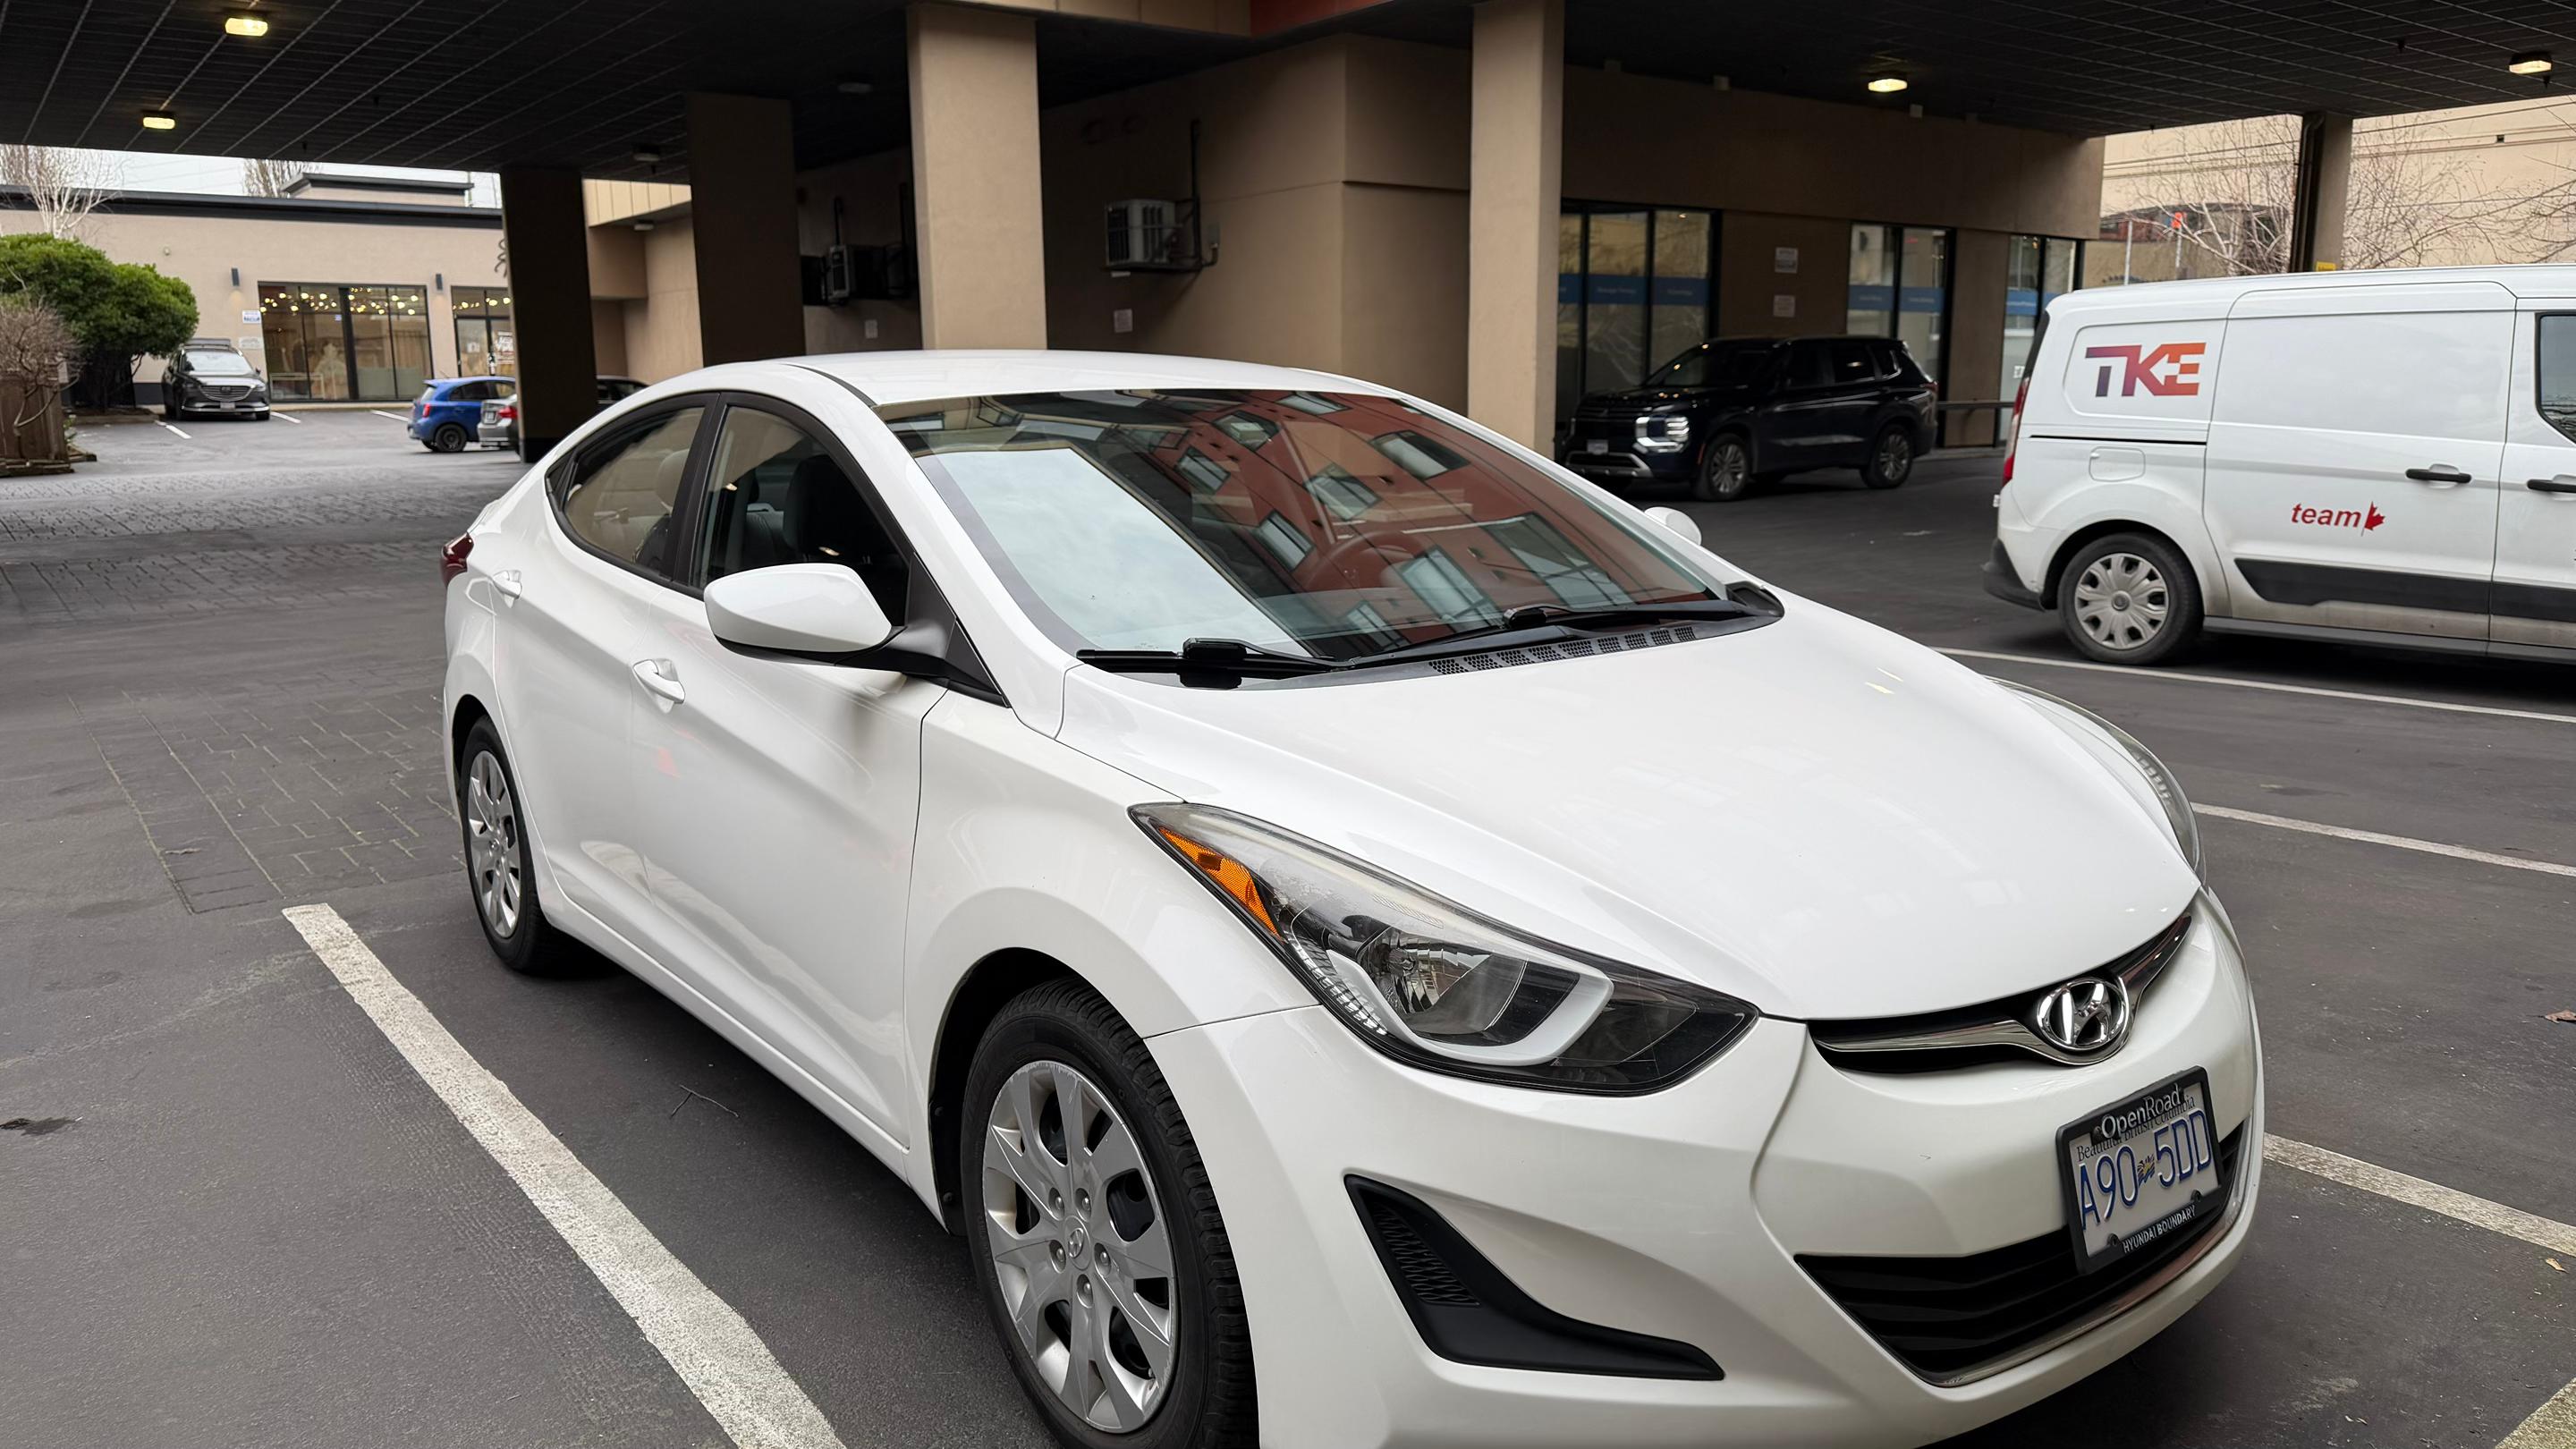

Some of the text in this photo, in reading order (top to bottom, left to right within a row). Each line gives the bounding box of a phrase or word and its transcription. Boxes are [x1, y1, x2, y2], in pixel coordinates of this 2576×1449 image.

[2085, 342, 2207, 398] TKE
[2292, 503, 2361, 528] team
[2102, 1083, 2182, 1140] OpenRoad
[2078, 1144, 2139, 1231] A90
[2122, 1204, 2196, 1253] HYUNDAI BOUNDARY
